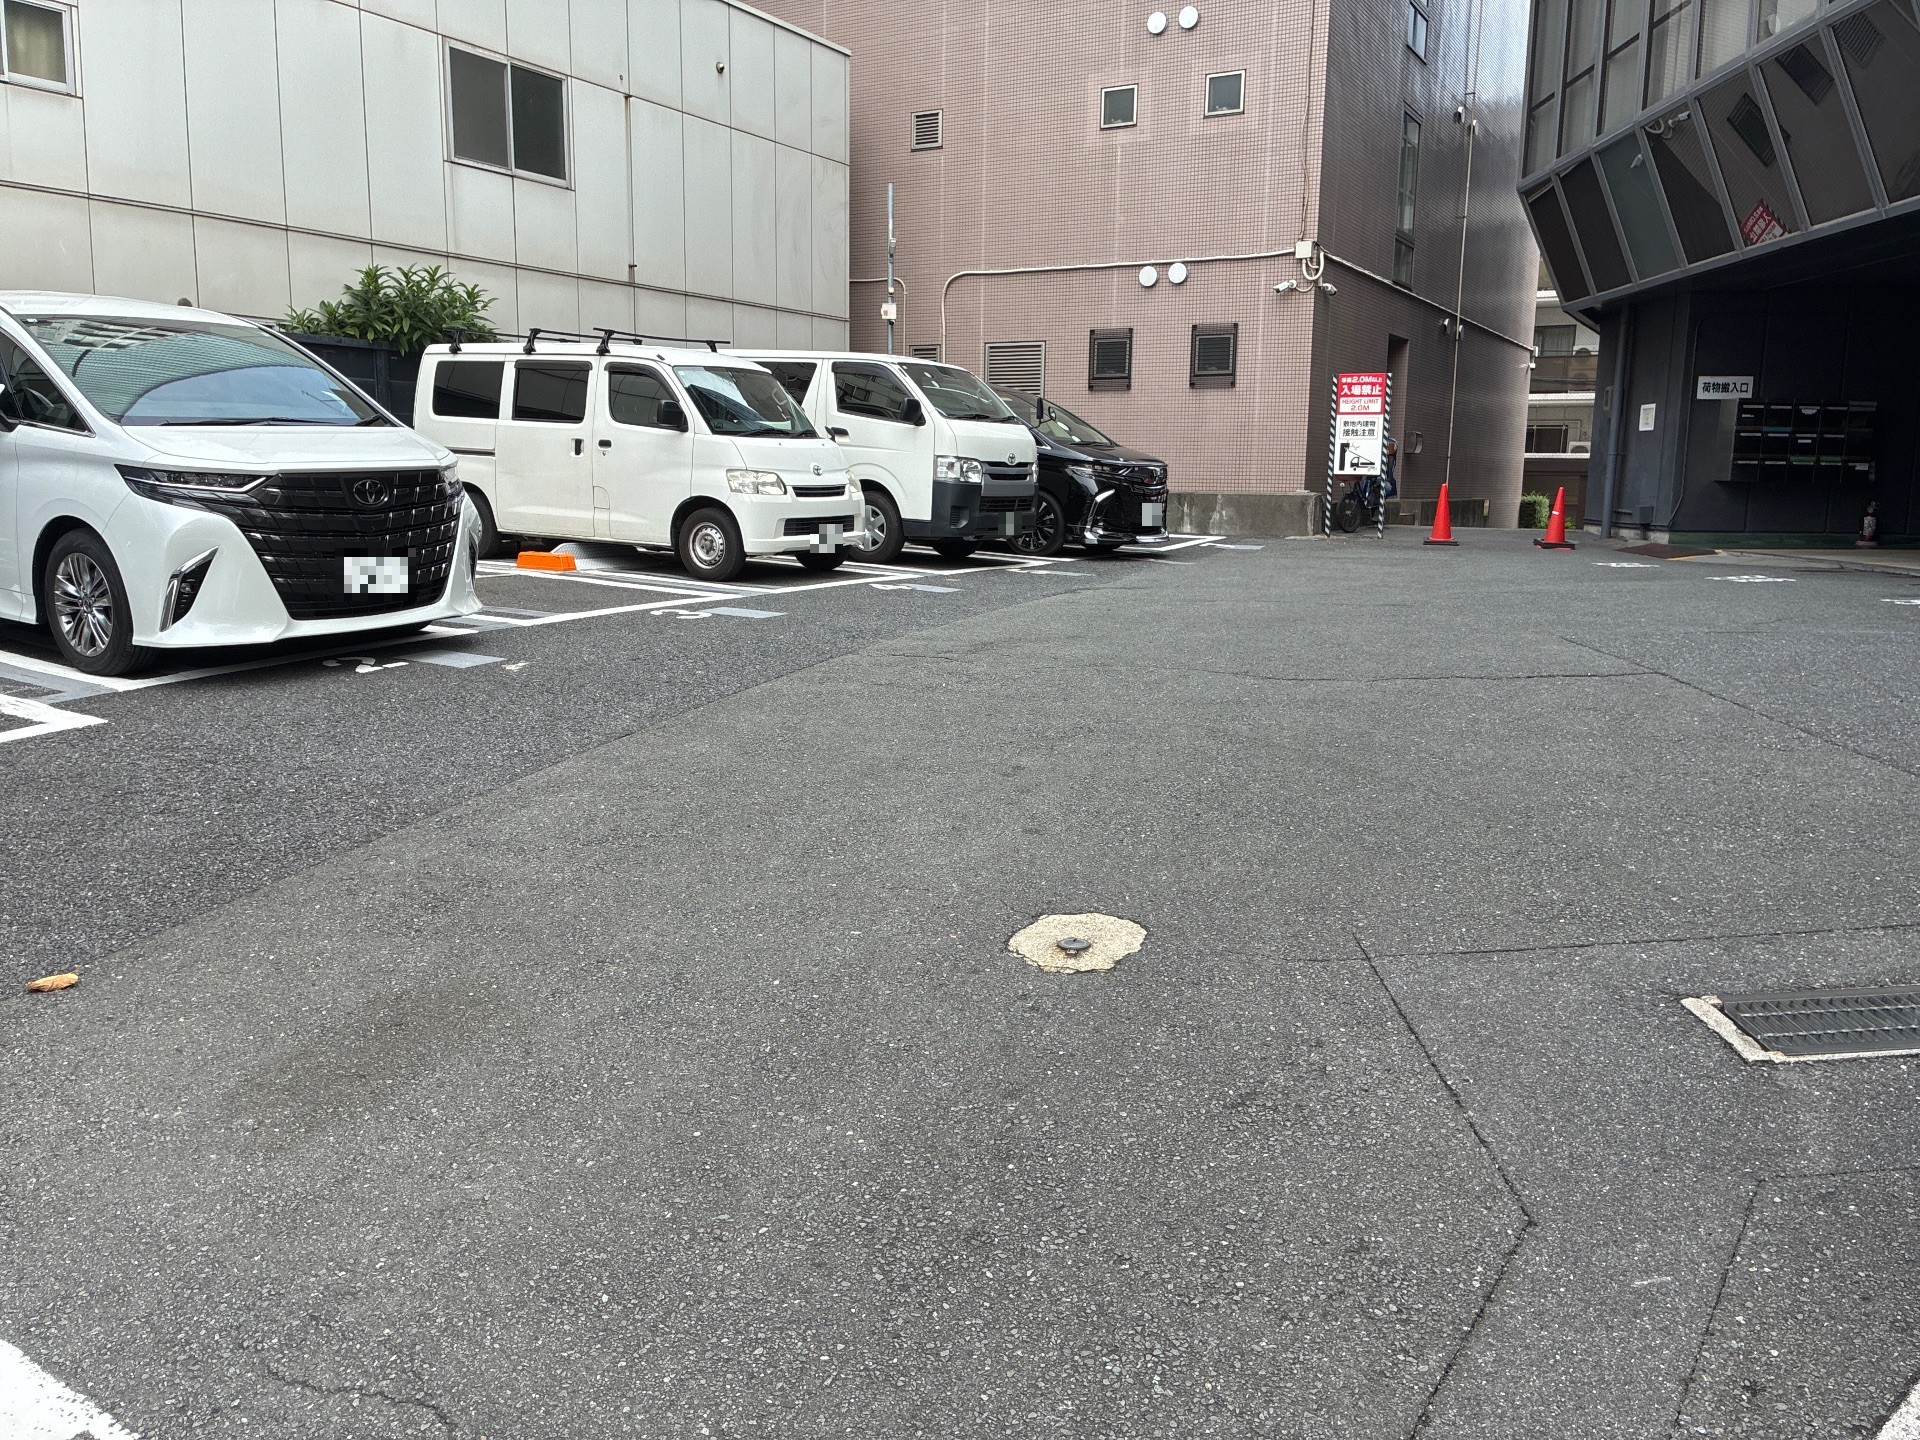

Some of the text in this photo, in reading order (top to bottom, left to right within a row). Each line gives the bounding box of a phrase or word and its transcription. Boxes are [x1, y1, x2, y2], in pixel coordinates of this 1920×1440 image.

[1341, 384, 1382, 395] 入場禁止
[1702, 381, 1749, 393] 荷物搬入口
[1342, 429, 1375, 437] 接触注意
[650, 609, 712, 619] 3
[322, 656, 410, 674] 2
